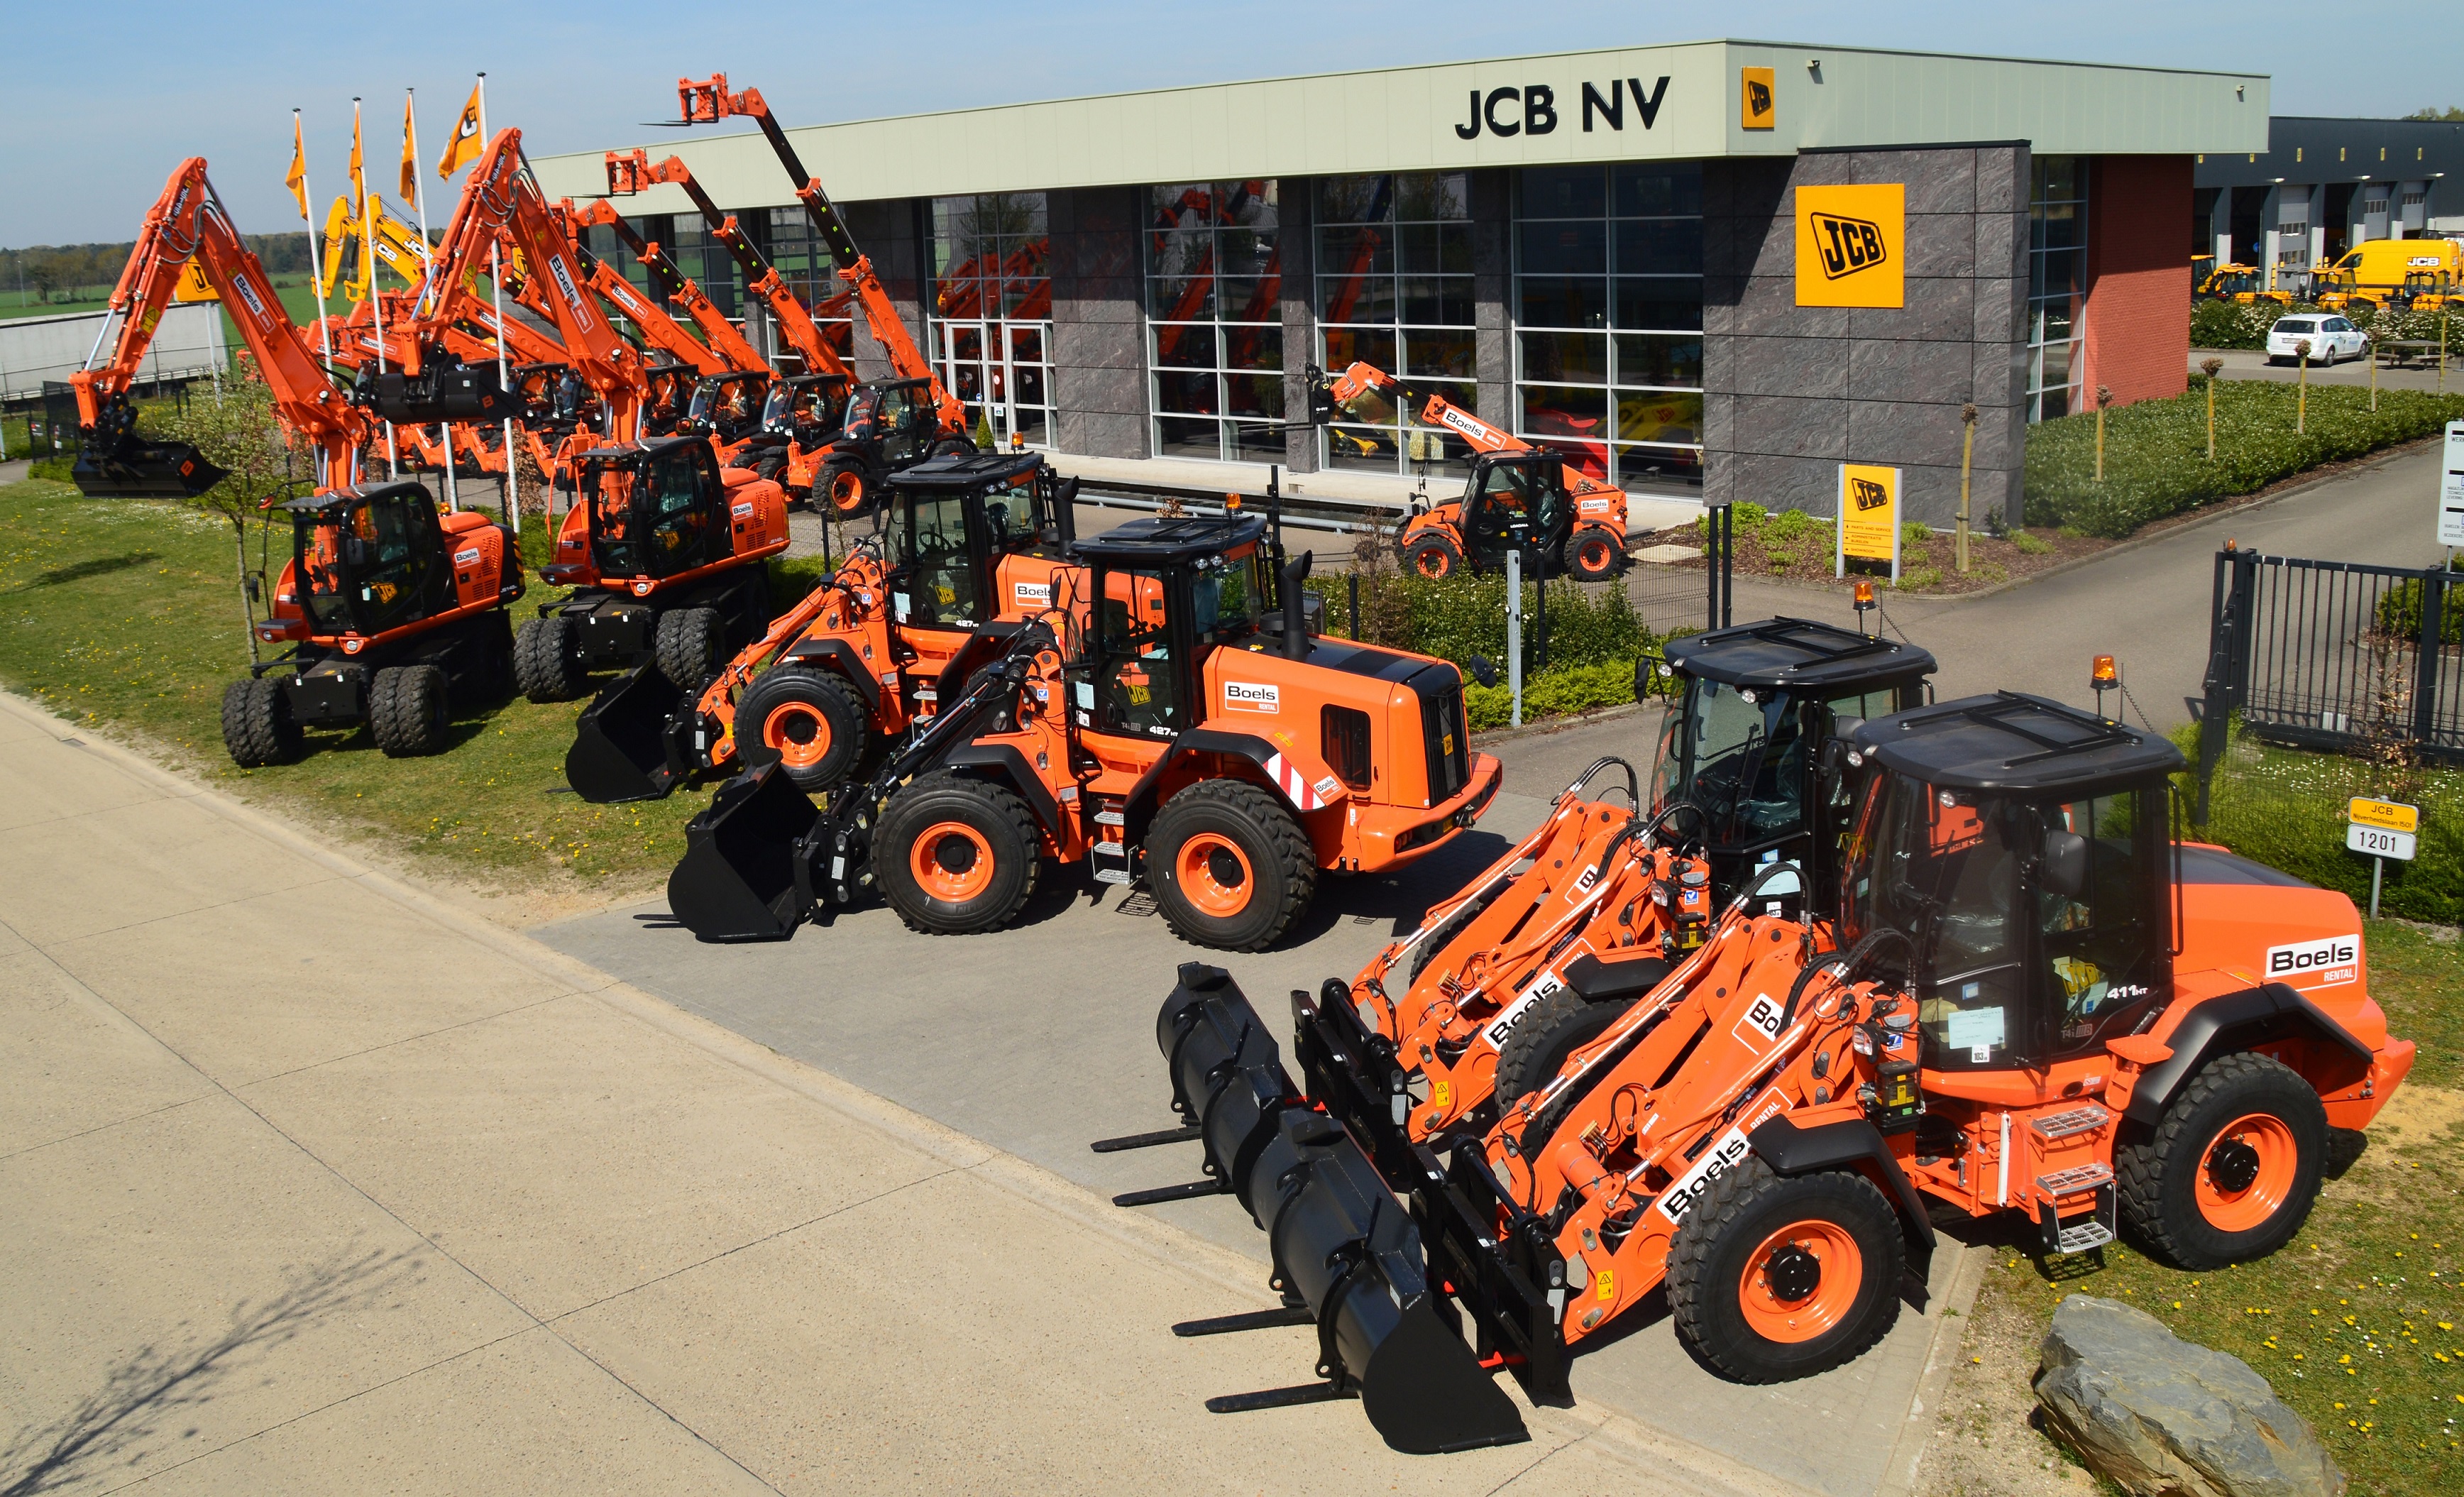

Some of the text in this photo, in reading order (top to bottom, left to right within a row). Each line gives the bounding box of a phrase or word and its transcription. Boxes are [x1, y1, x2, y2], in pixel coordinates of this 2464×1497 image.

[1455, 76, 1671, 140] JCB NV
[377, 243, 398, 262] CB
[1823, 219, 1881, 273] JCB
[2407, 257, 2440, 266] JCB
[551, 256, 576, 303] Boels
[236, 277, 260, 312] Boels
[614, 287, 635, 308] Boels
[1446, 412, 1483, 437] Boels
[1857, 481, 1886, 508] JCB
[733, 505, 752, 514] Boels
[1582, 499, 1607, 508] Boels
[665, 532, 679, 548] JCB
[456, 551, 478, 561] Boels
[379, 585, 397, 601] JCB
[939, 590, 955, 603] JCB
[1130, 685, 1150, 703] JCB
[1228, 686, 1275, 701] Boels
[1316, 779, 1335, 792] Boels
[2371, 805, 2393, 816] JCB
[2353, 813, 2398, 826] Nijverheidslaan
[2360, 831, 2396, 852] 1201
[2271, 943, 2353, 972] Boels
[2066, 965, 2097, 993] JCB
[2323, 967, 2354, 982] RENTAL
[1974, 1053, 1984, 1061] 103
[1664, 1101, 1781, 1217] Boels RENTAL
